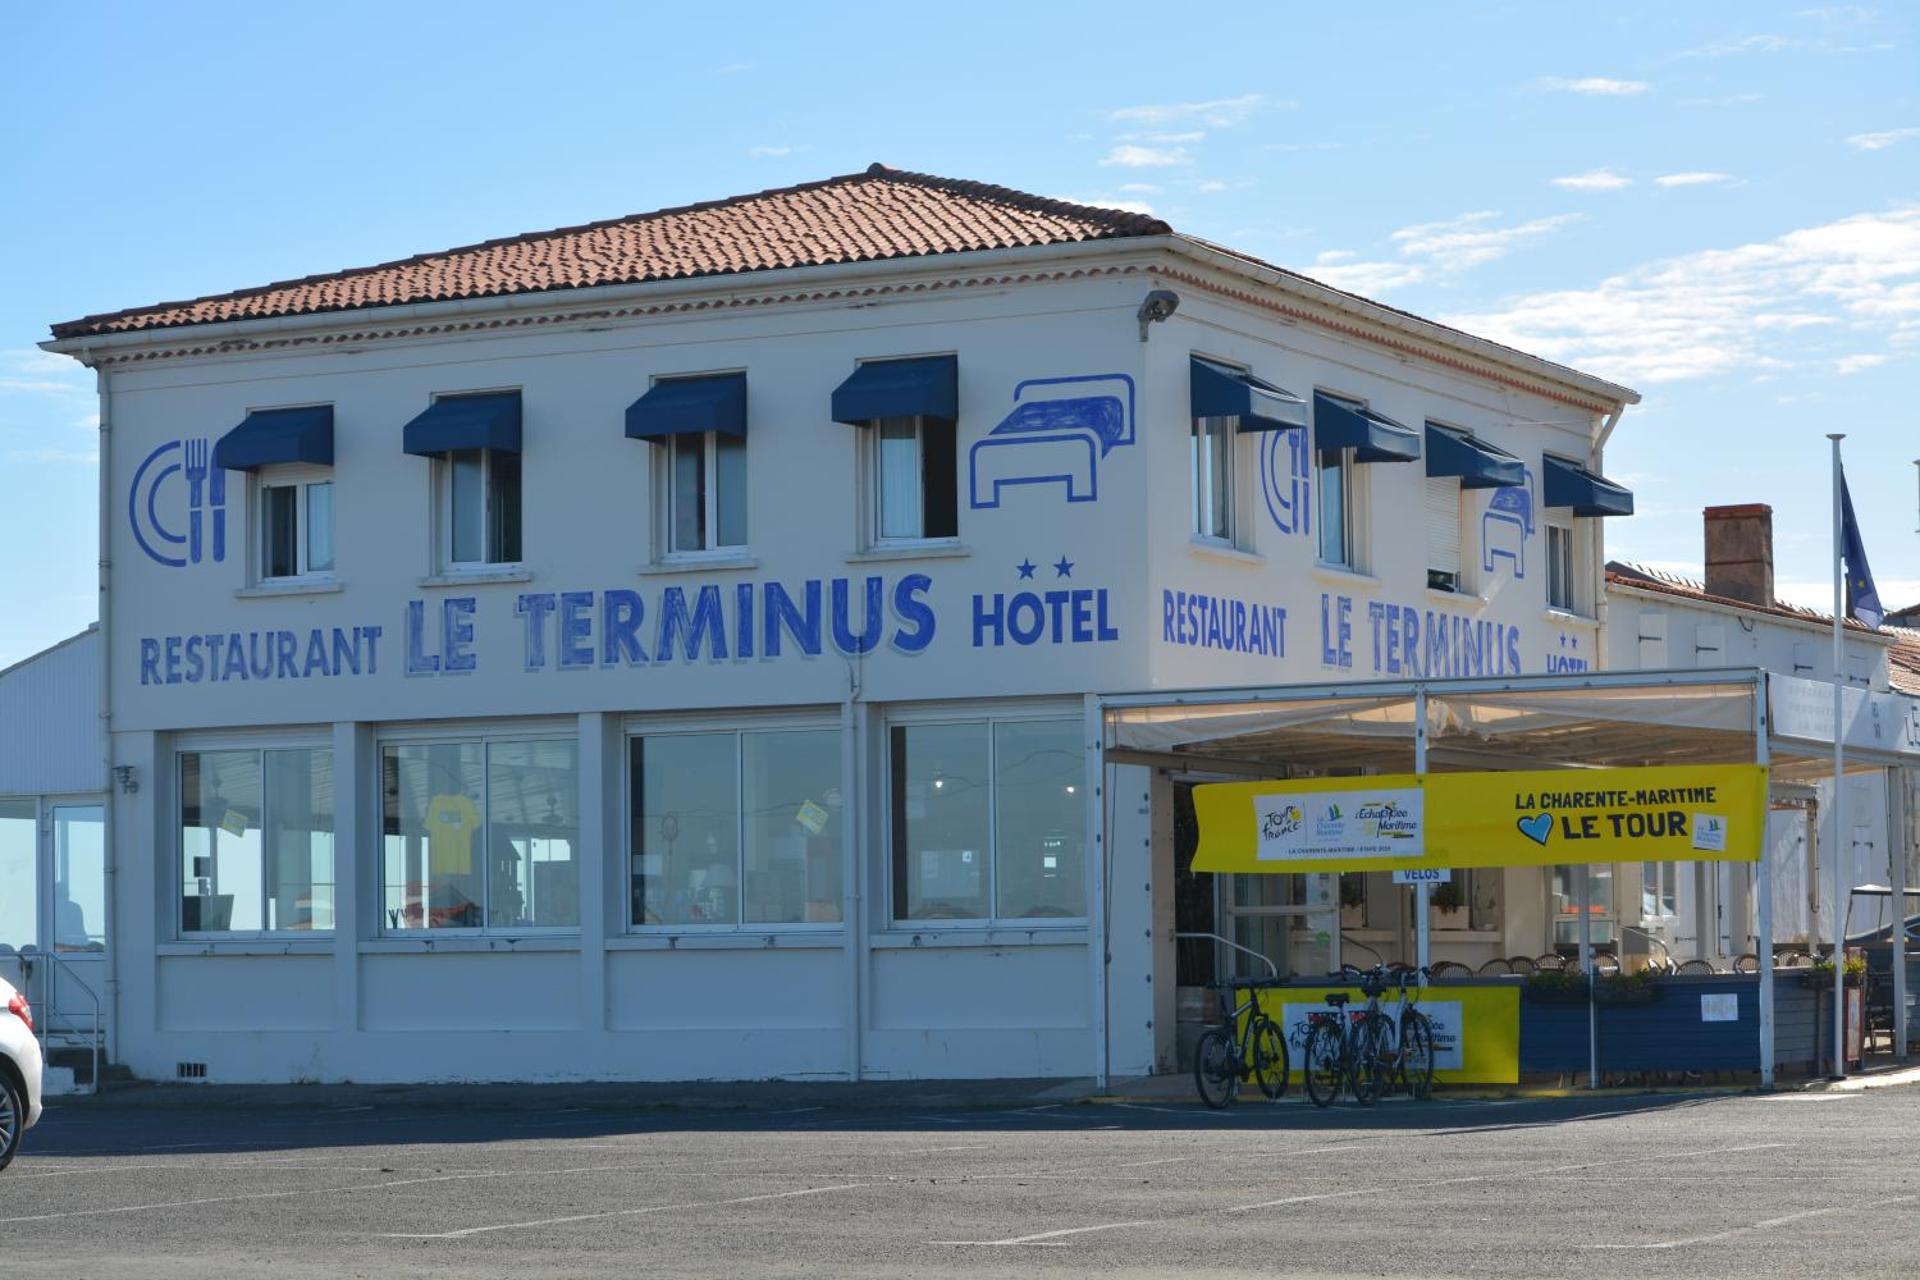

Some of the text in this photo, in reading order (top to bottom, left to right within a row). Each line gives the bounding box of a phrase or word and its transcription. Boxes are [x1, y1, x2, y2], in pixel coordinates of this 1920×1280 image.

[406, 572, 937, 676] LE TERMINUS
[971, 588, 1118, 649] HOTEL
[1163, 590, 1286, 657] RESTAURANT
[1322, 593, 1521, 677] LE TERMINUS
[140, 625, 383, 685] RESTAURANT
[1515, 786, 1717, 810] LA CHARENTE-MARITIME
[1561, 815, 1601, 840] LE
[1606, 810, 1688, 838] TOUR
